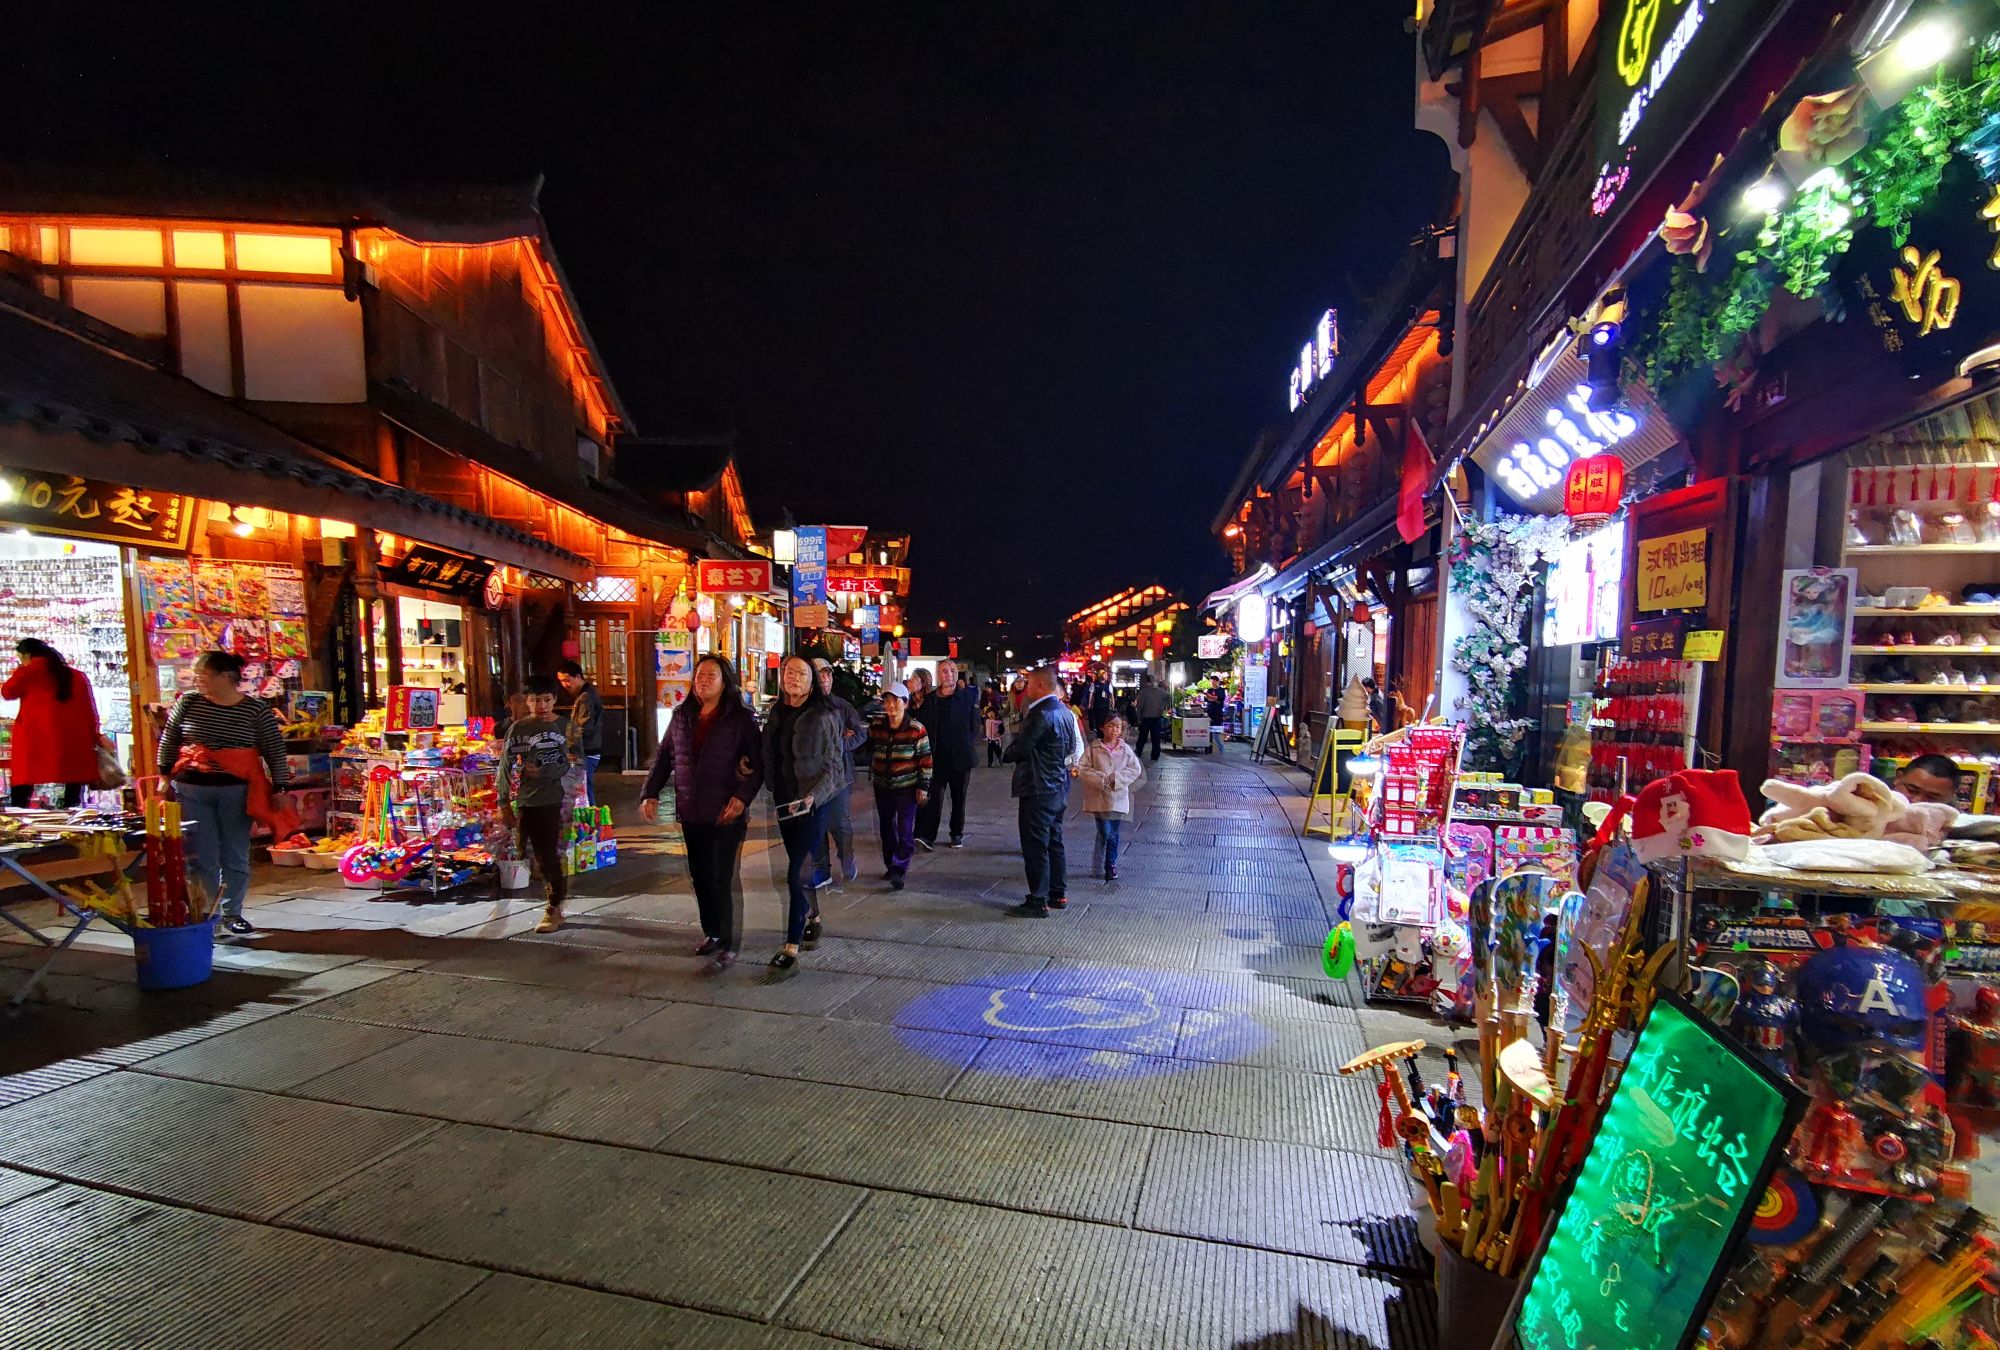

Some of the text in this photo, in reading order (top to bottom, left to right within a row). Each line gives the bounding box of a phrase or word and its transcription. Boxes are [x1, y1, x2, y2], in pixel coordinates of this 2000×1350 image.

[1647, 540, 1705, 572] 汉服出租
[1631, 631, 1675, 654] 百家姓
[1858, 979, 1899, 1017] A
